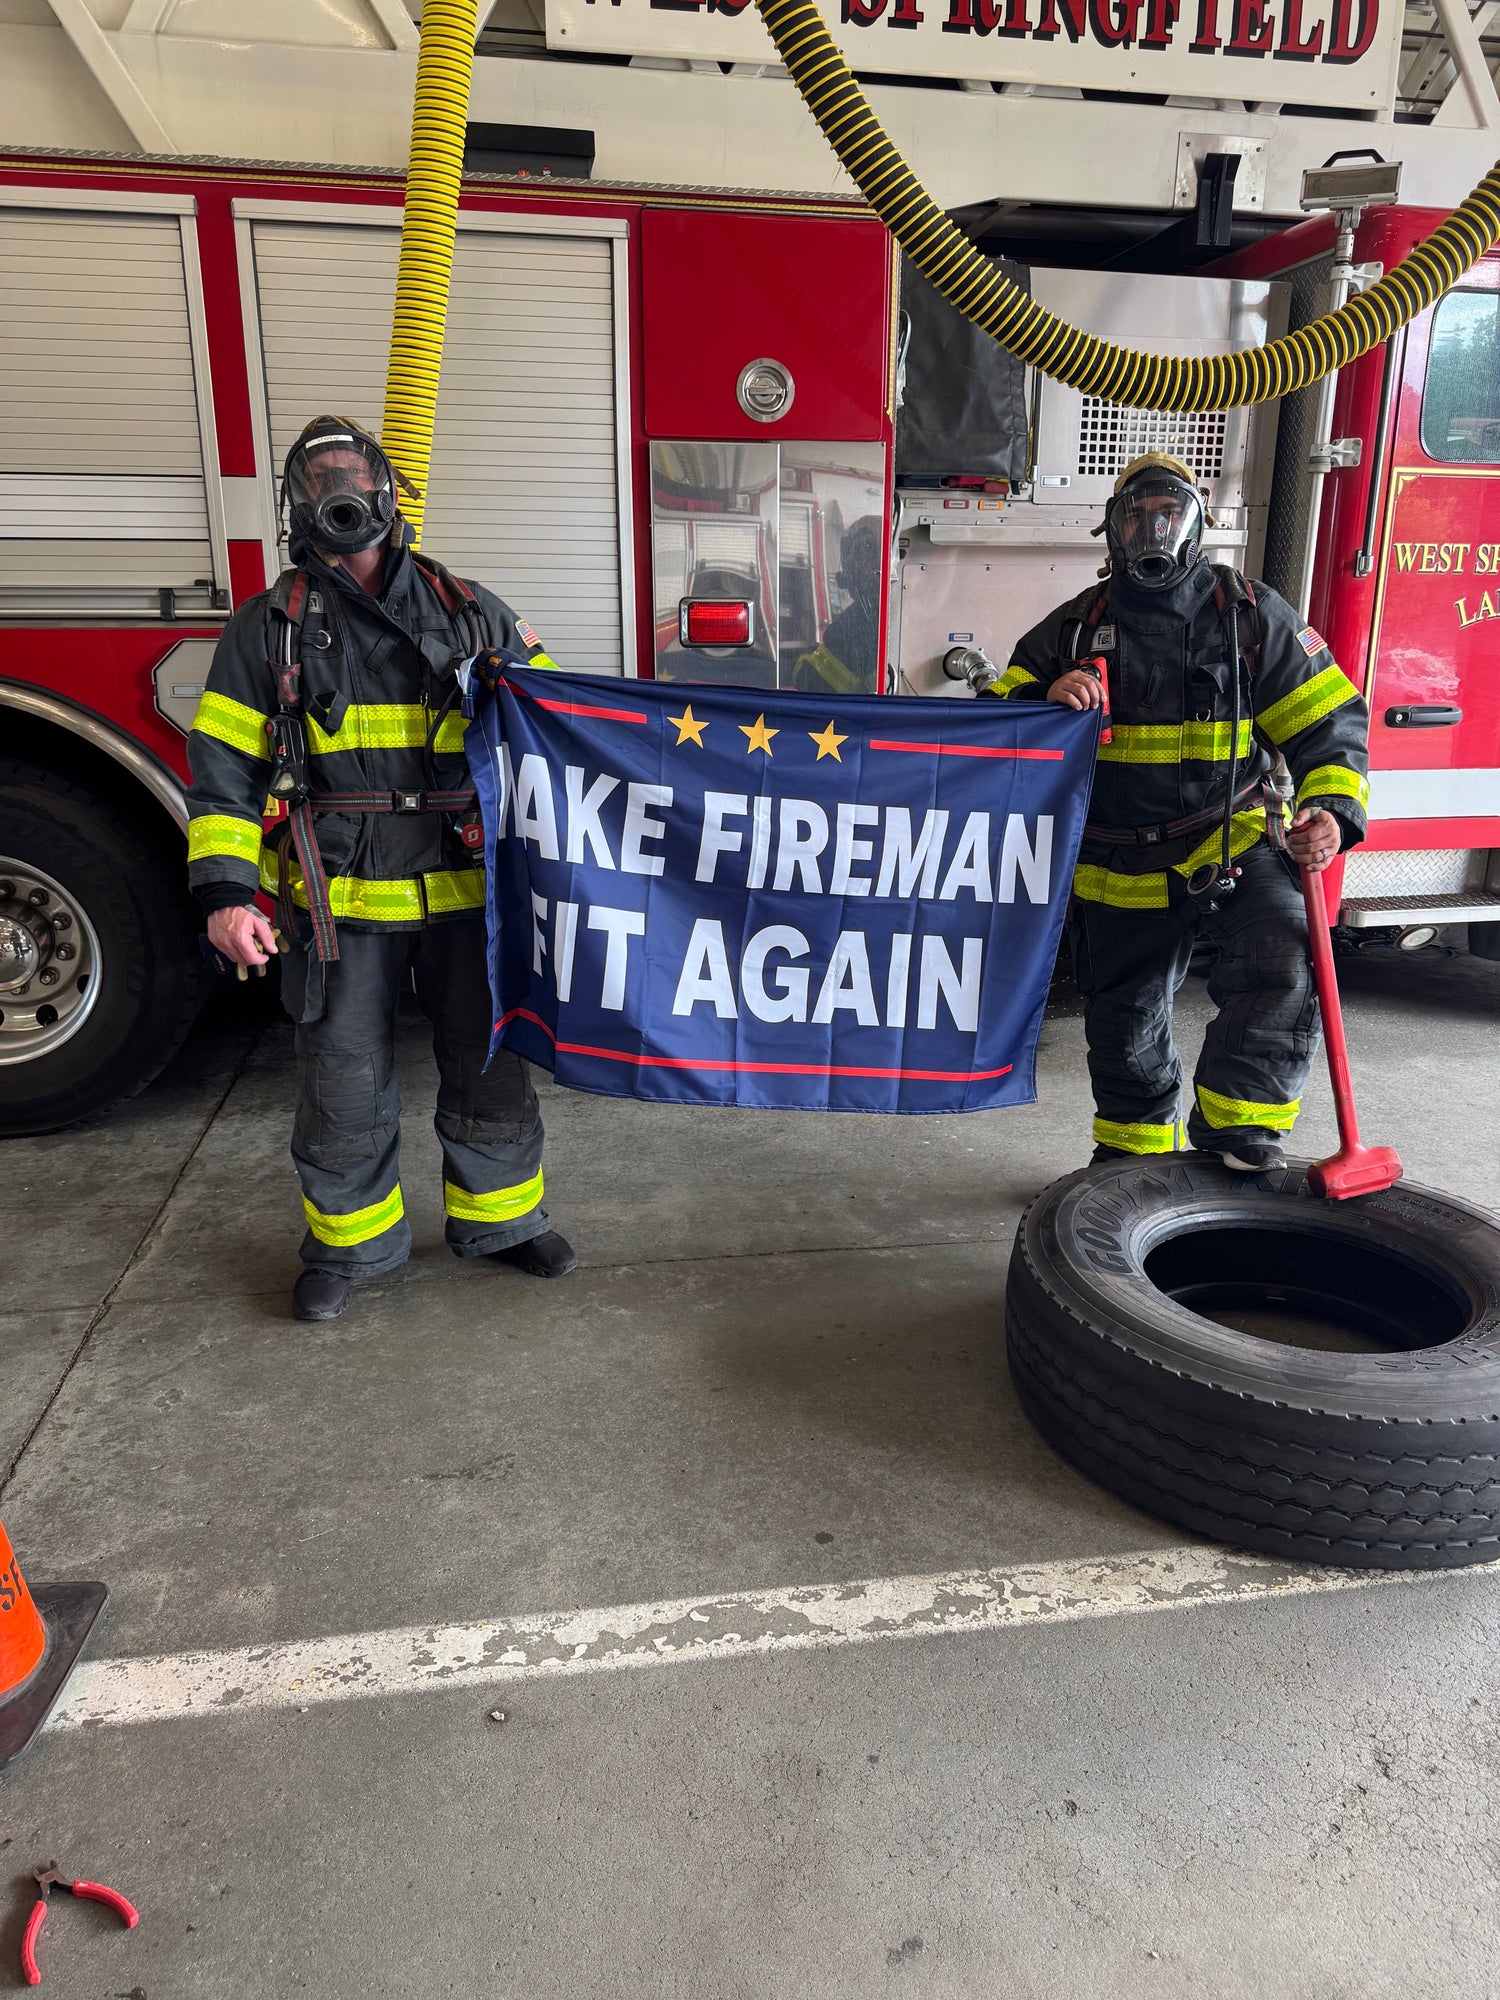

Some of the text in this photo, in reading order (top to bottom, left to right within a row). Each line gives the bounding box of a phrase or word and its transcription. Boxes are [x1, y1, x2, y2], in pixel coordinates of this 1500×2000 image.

[1393, 543, 1471, 574] WEST
[1453, 588, 1500, 630] LA
[695, 791, 1054, 904] FIREMAN
[531, 886, 983, 1033] FIT AGAIN
